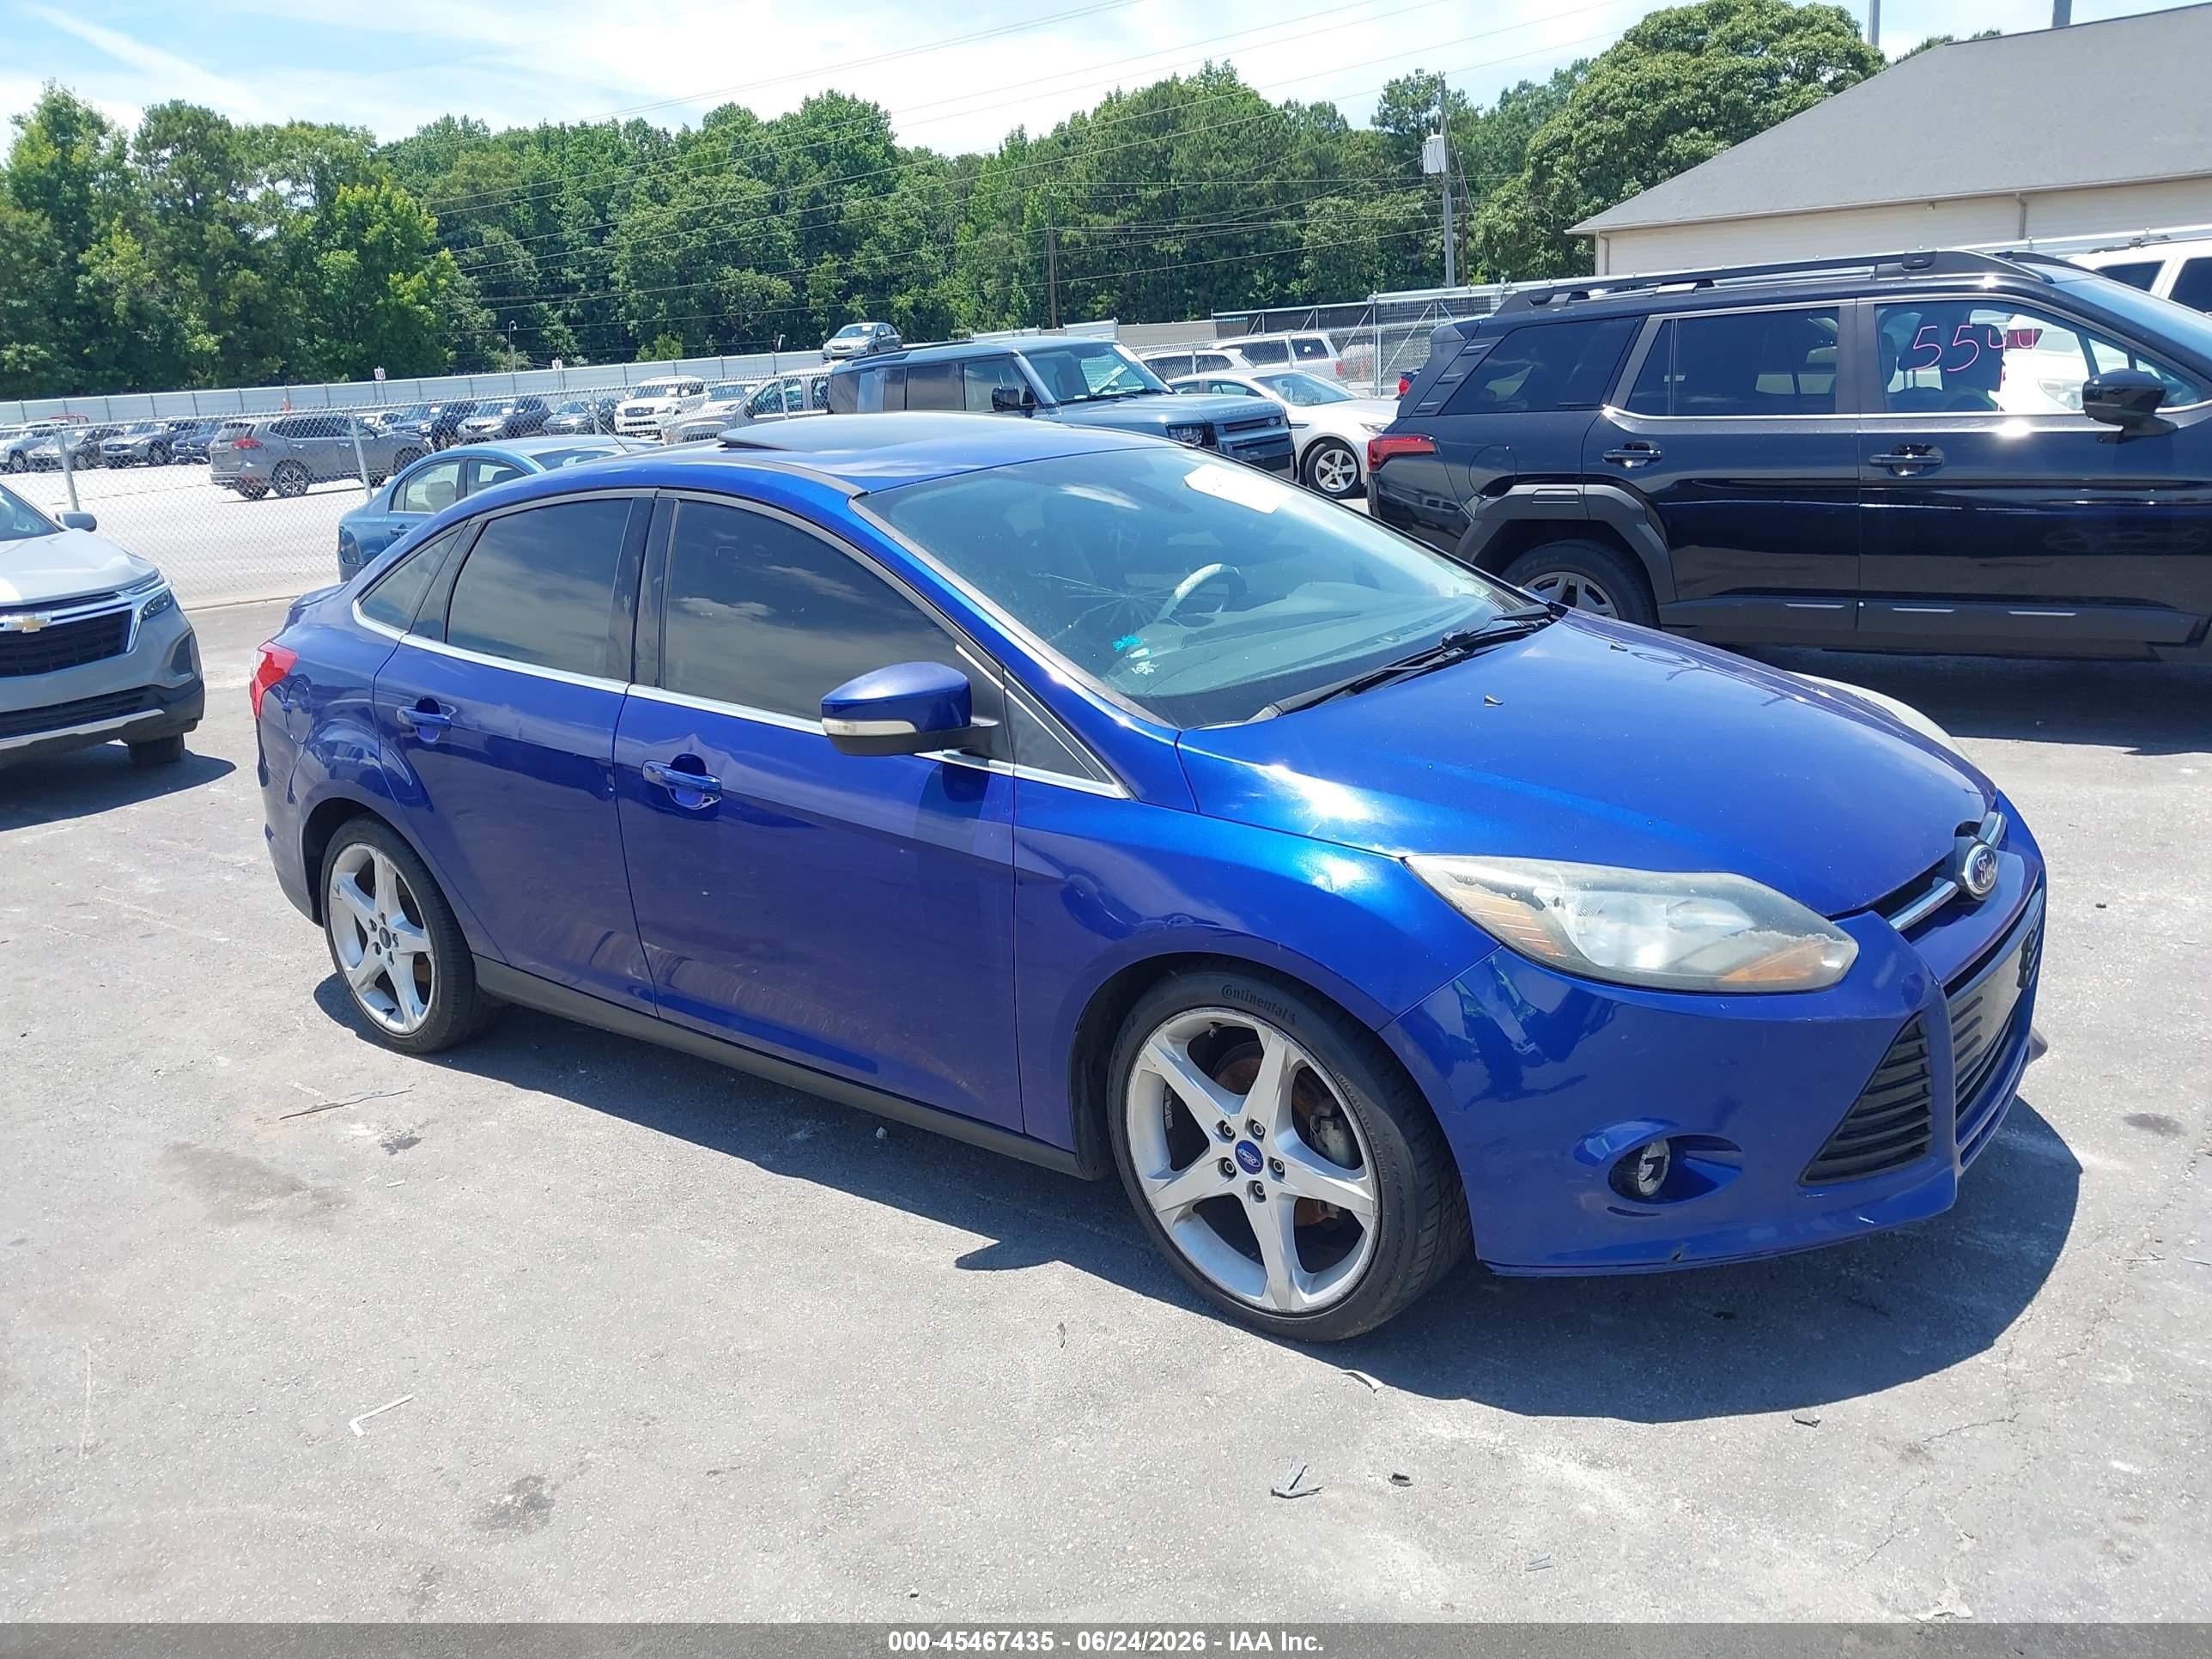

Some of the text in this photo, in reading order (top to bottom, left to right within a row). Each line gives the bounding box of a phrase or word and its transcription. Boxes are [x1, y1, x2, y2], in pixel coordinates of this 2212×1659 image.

[1912, 325, 2035, 373] 5544
[375, 369, 385, 379] 10
[1977, 853, 1997, 884] Ford
[1221, 984, 1288, 1019] Continental
